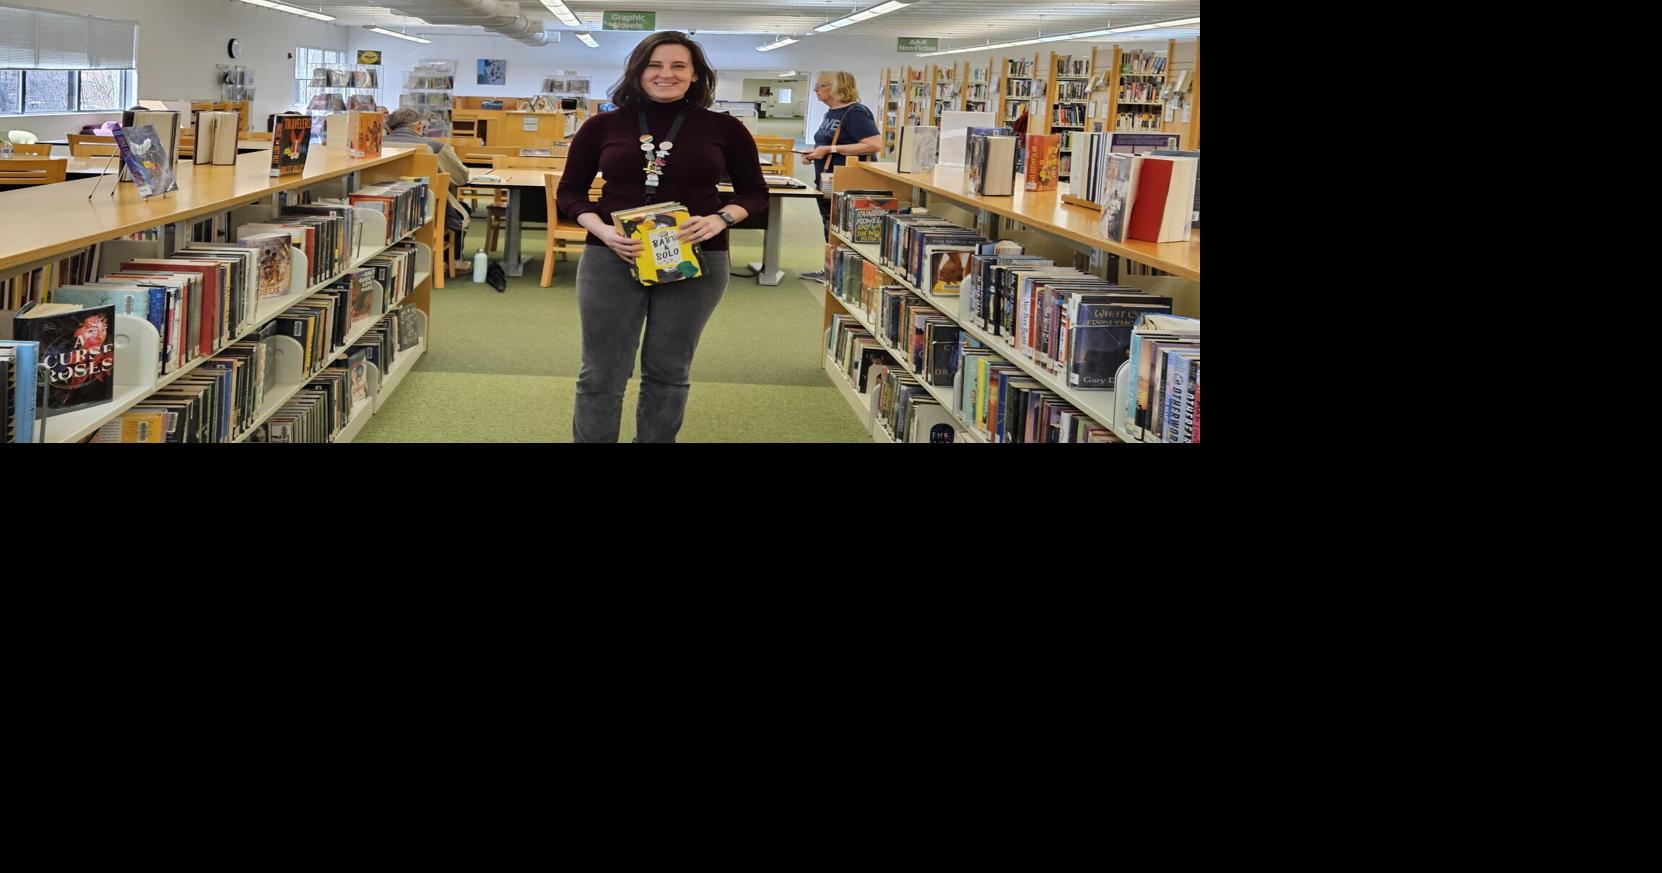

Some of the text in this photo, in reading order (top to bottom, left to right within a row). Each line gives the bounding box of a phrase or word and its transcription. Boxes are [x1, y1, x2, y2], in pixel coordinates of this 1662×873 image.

[612, 13, 645, 22] Graphic
[612, 21, 642, 29] Novels
[285, 118, 312, 129] TRAVELERS
[856, 216, 881, 224] ROWEL
[656, 248, 679, 261] SOLO
[74, 335, 85, 349] A
[43, 343, 113, 370] CURSE
[49, 357, 113, 383] ROSES
[1083, 376, 1106, 385] Gary
[1170, 386, 1182, 443] OTHERWOR
[1184, 394, 1194, 443] OTHEREAR
[932, 432, 949, 440] THE
